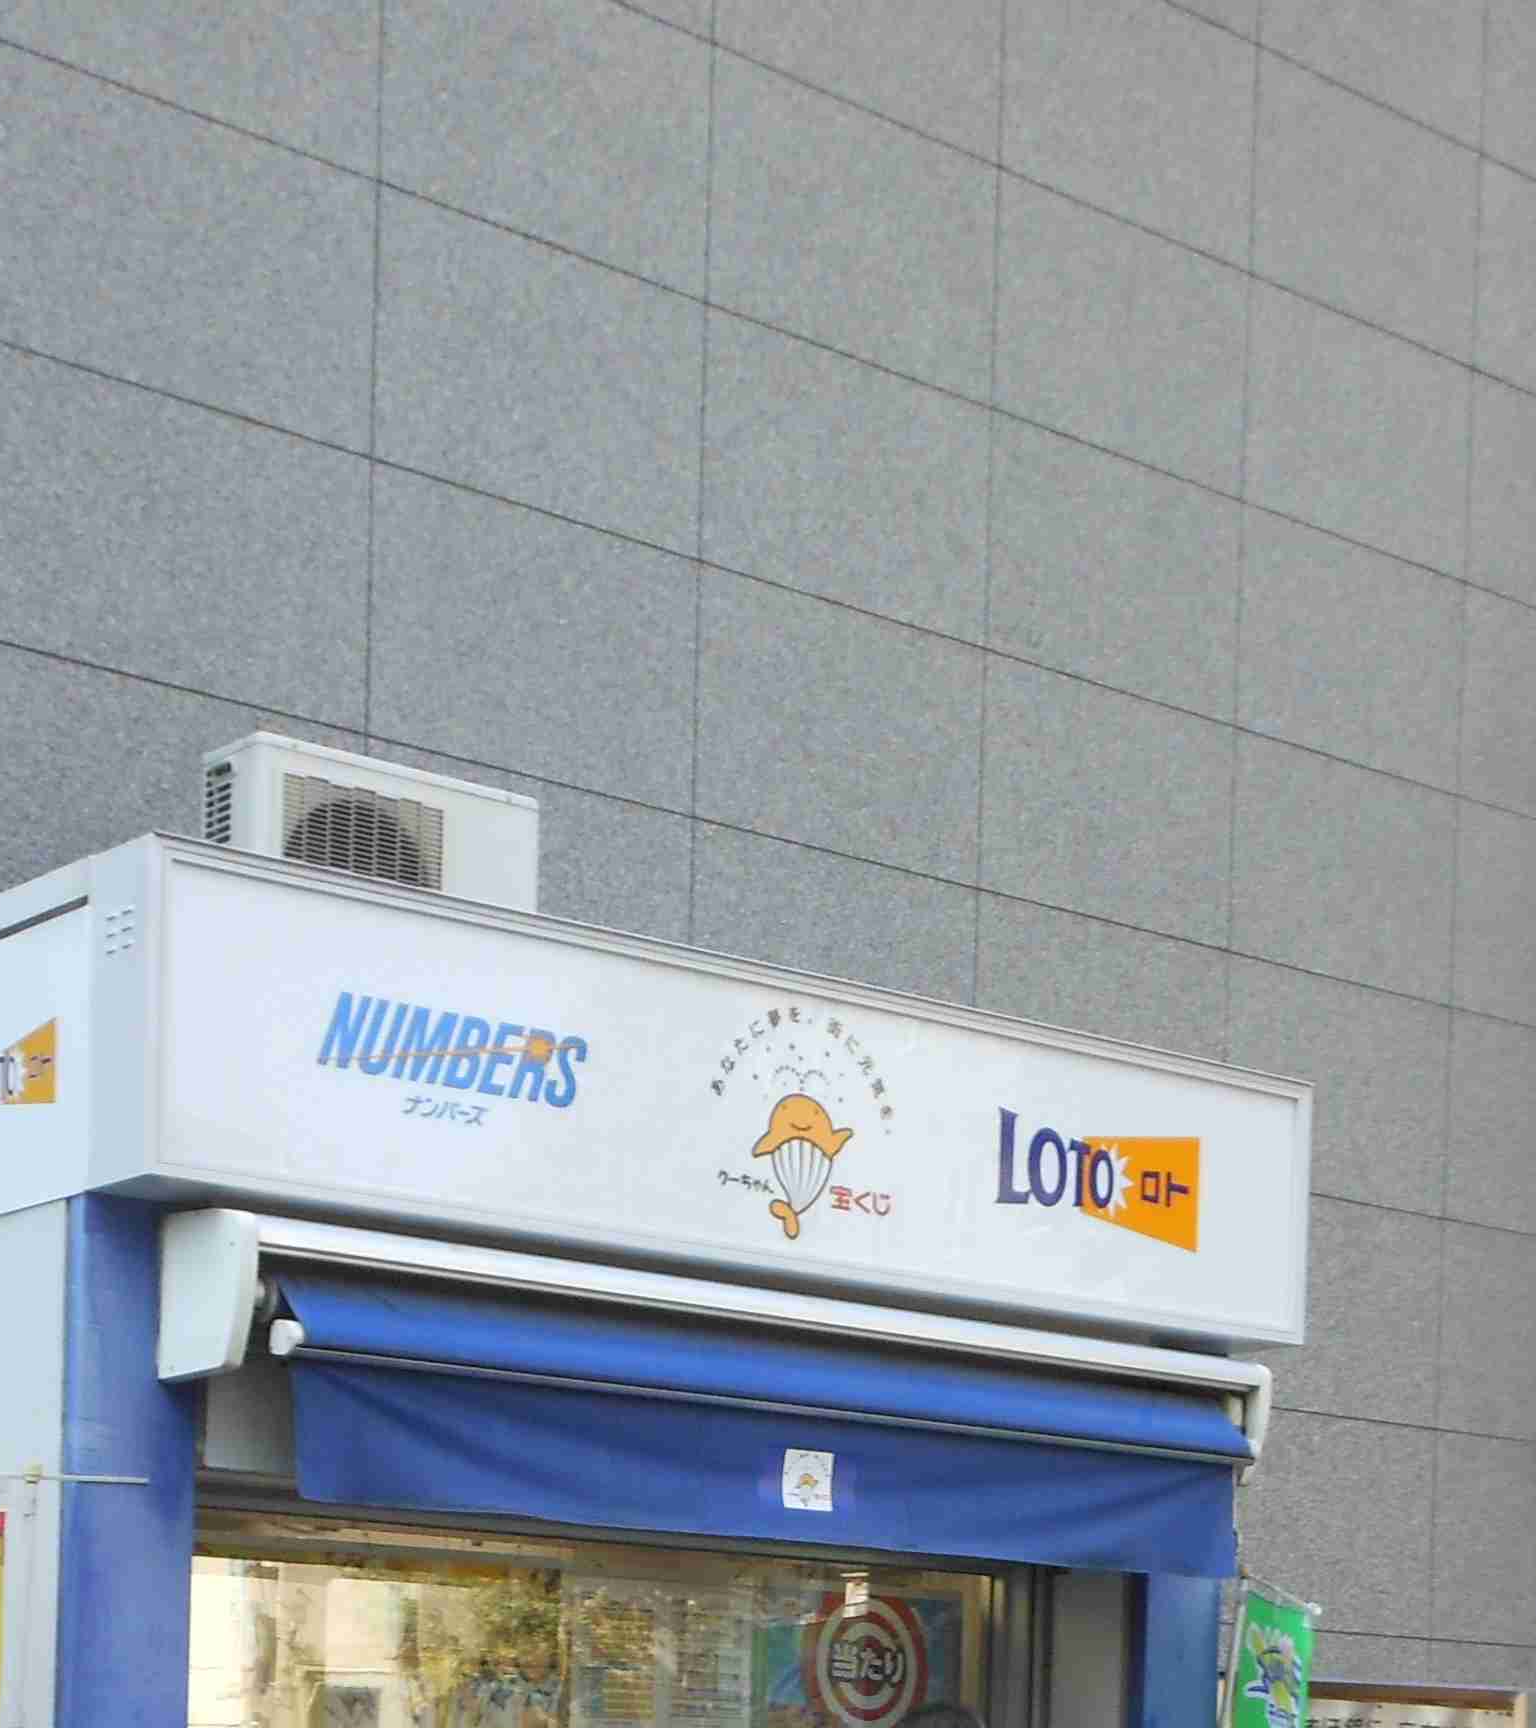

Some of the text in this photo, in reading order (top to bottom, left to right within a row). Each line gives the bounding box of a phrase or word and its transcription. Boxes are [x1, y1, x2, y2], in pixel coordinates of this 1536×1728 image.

[317, 991, 588, 1108] NUMBERS
[402, 1095, 488, 1126] ナンバーズ
[995, 1106, 1114, 1208] LOTO
[830, 1186, 892, 1216] 宝くじ
[1141, 1171, 1190, 1208] ロト
[829, 1640, 906, 1688] 当たり
